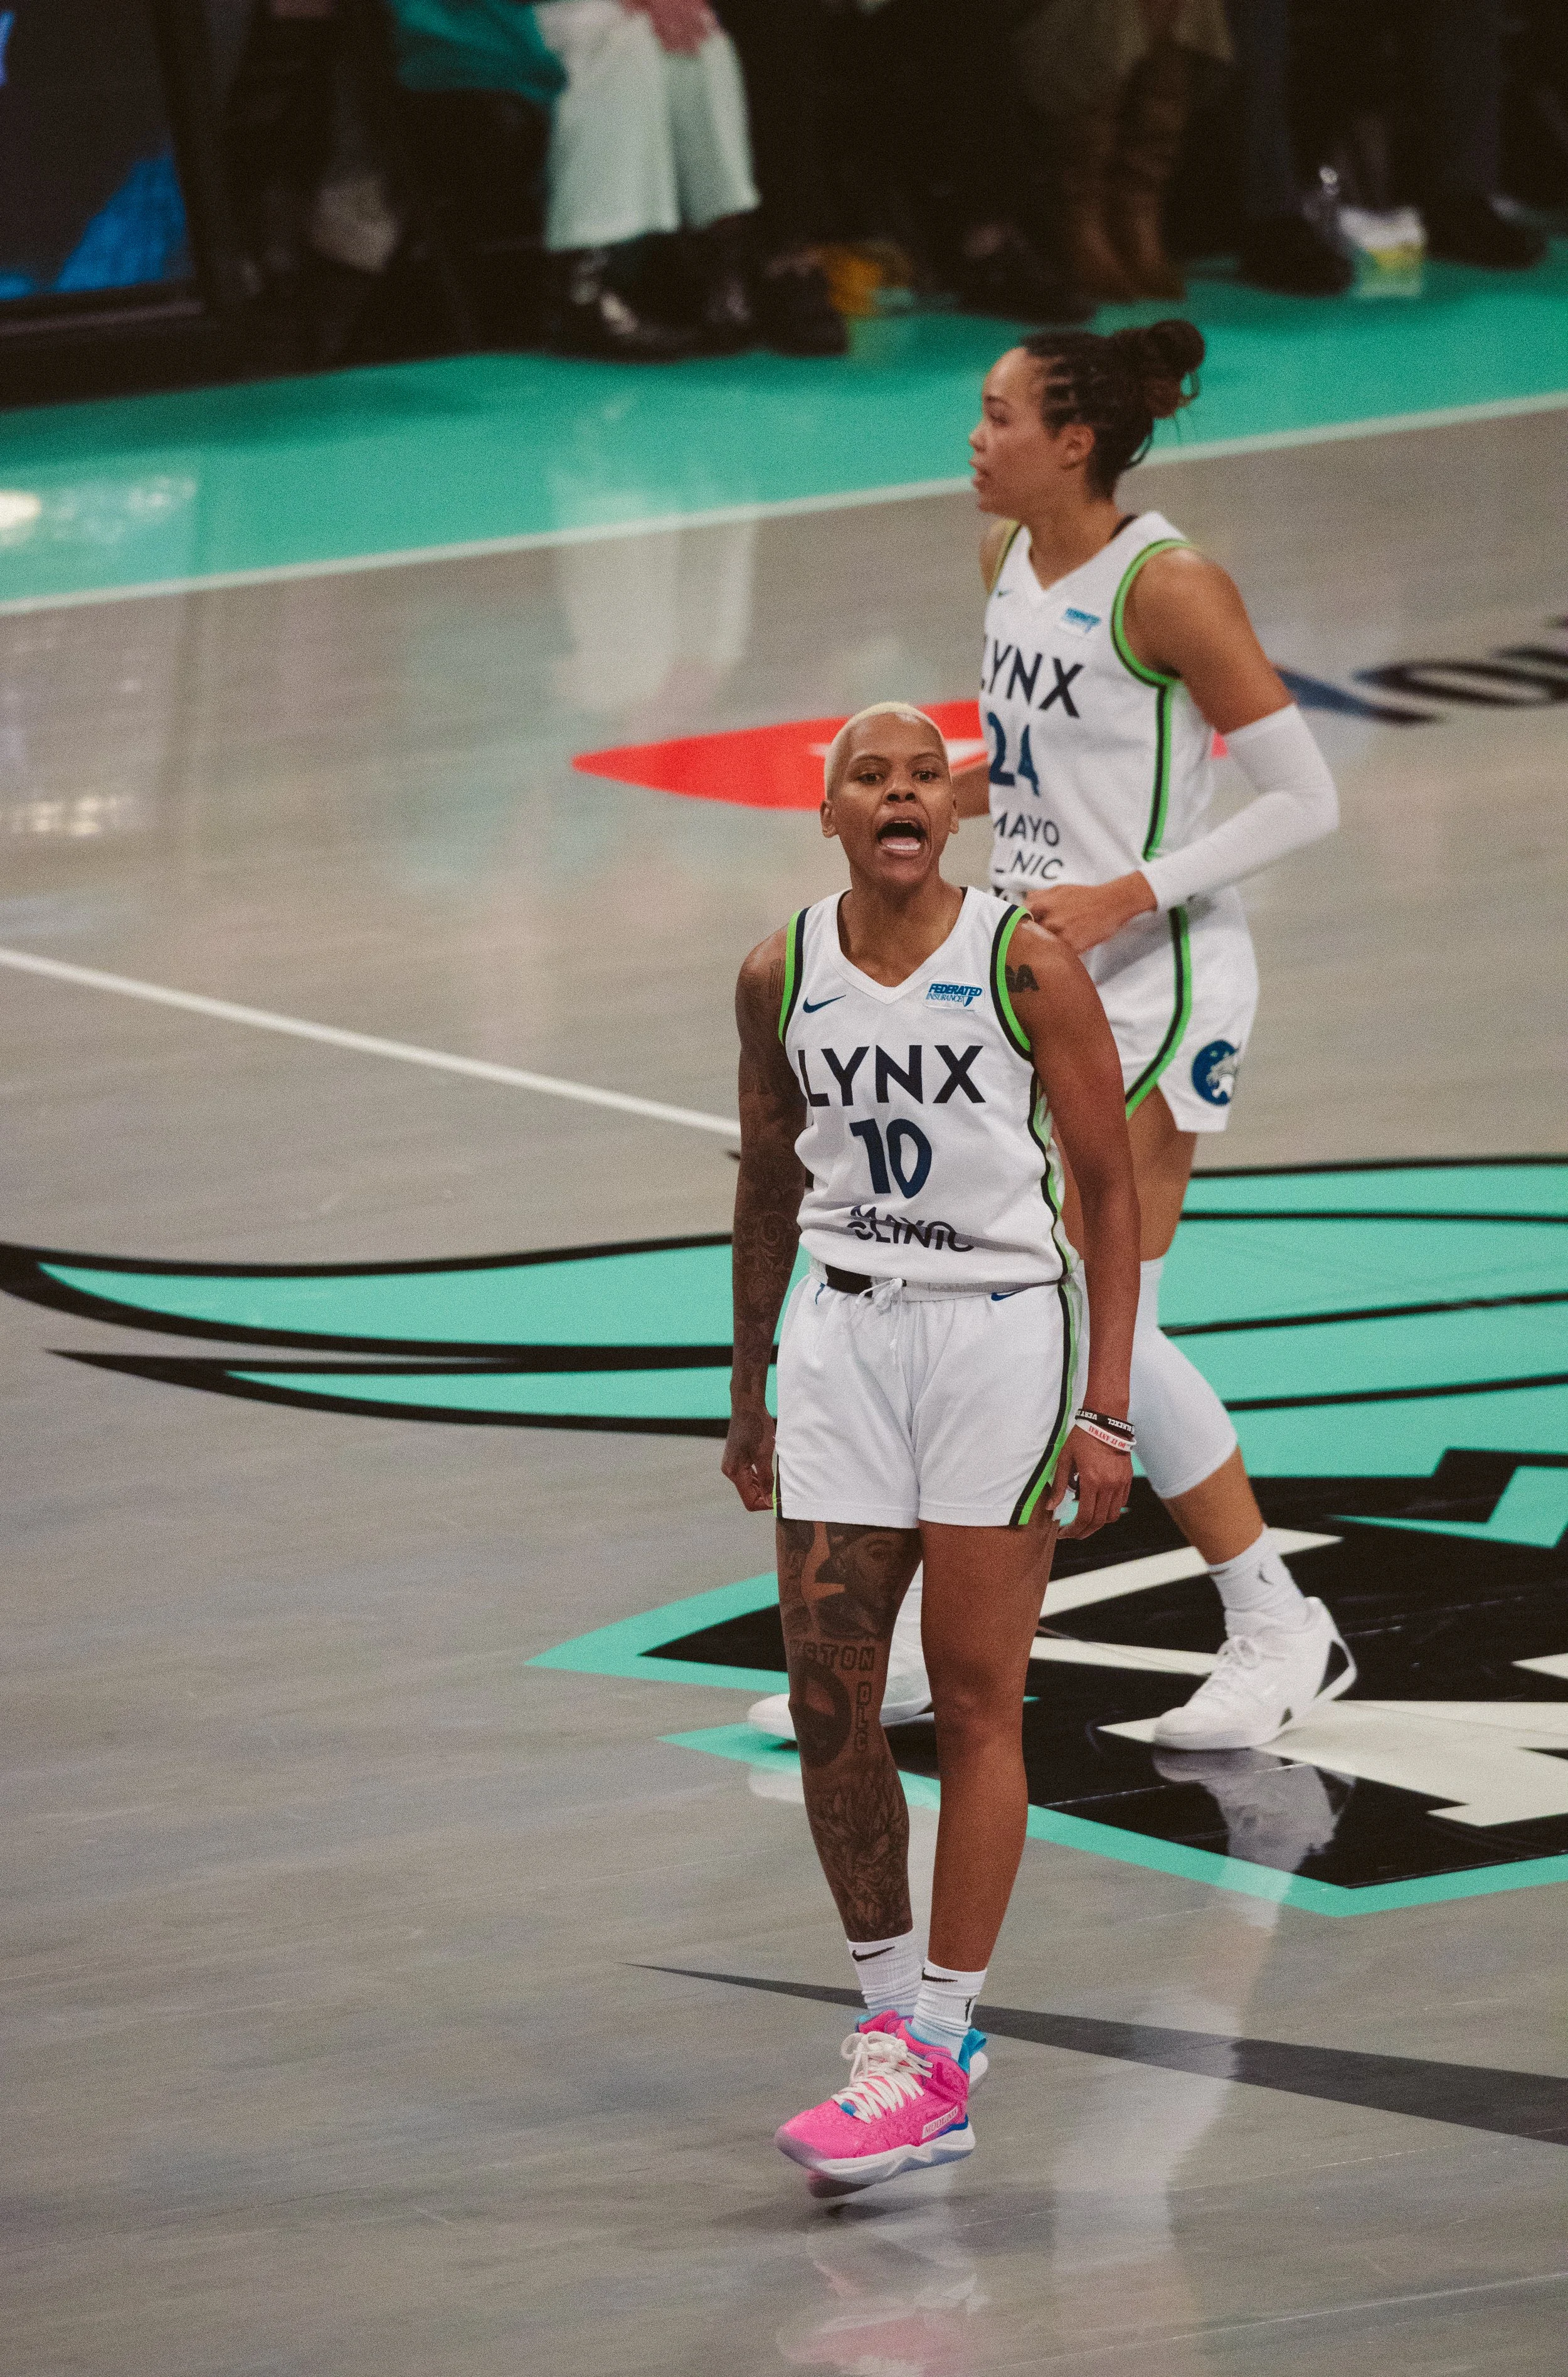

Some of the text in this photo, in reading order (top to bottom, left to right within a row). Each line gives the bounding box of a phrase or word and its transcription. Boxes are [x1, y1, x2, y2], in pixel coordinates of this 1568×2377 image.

[981, 639, 1084, 719] YNX
[926, 993, 963, 1002] INSURANCE
[928, 983, 983, 997] FEDERATED
[797, 1045, 987, 1107] LYNX
[849, 1119, 933, 1199] 10
